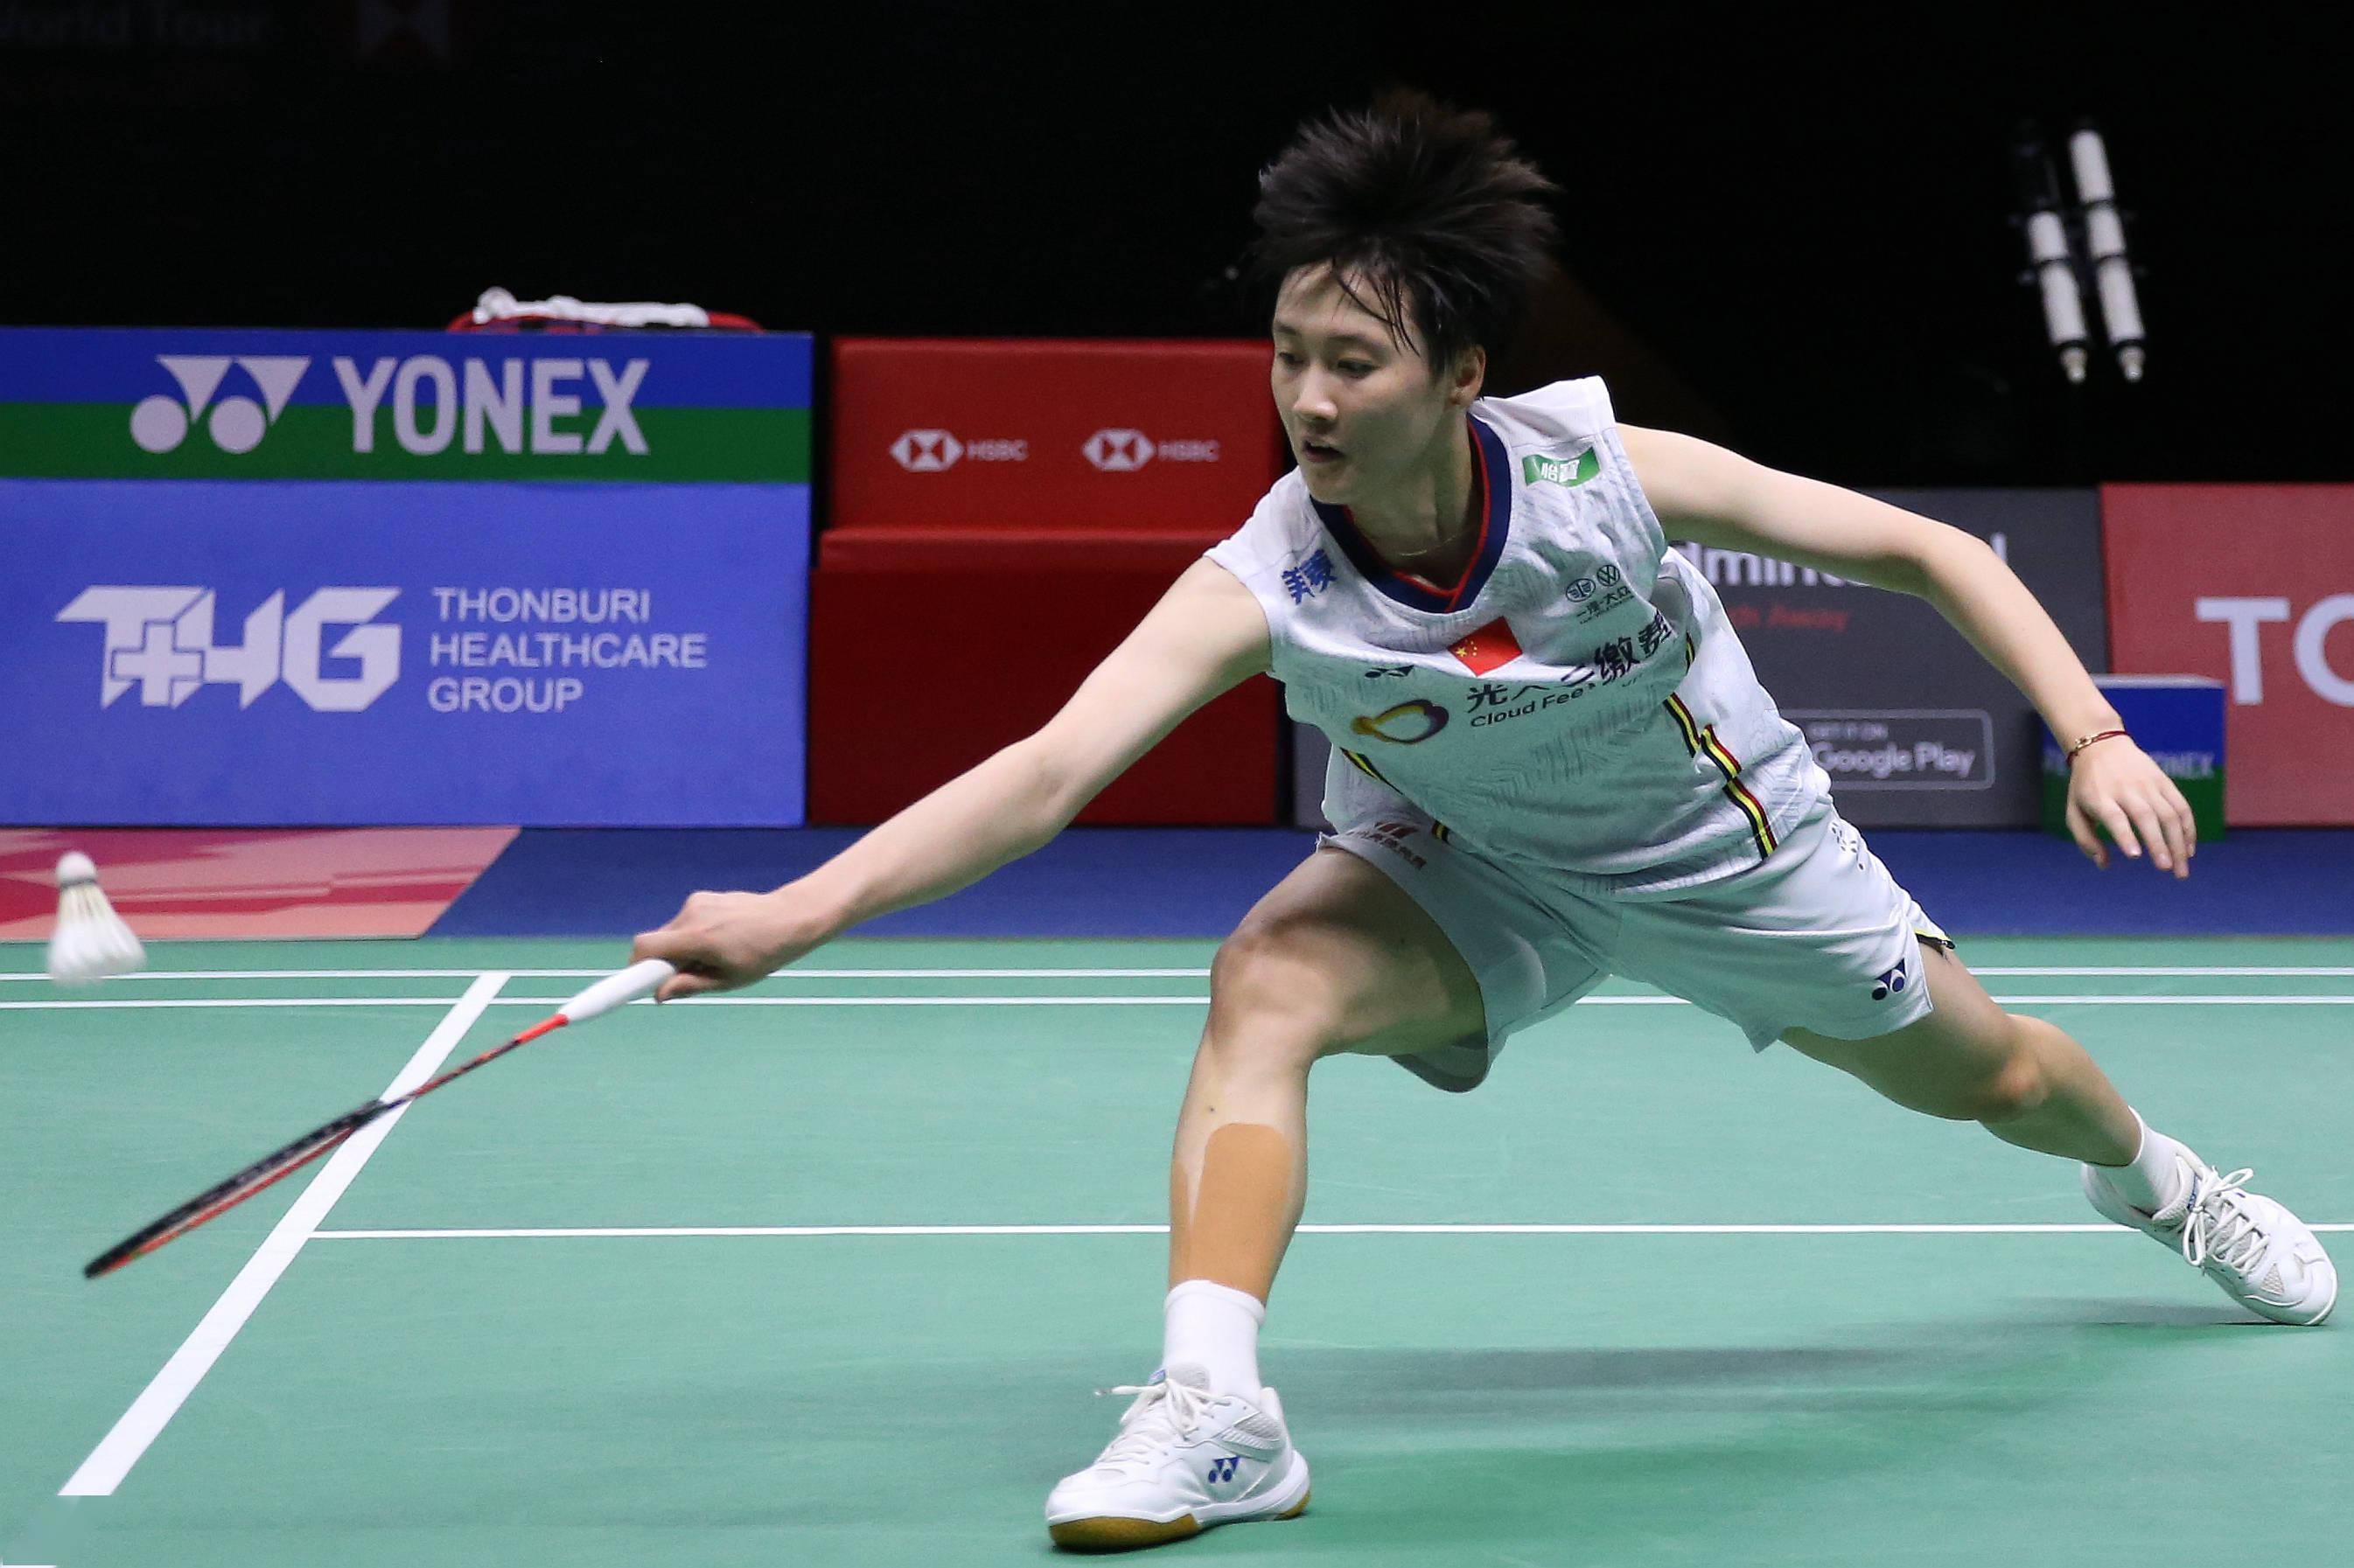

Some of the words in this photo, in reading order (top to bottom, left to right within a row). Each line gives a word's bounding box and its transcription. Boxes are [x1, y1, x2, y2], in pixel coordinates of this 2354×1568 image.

[332, 355, 651, 456] YONEX
[967, 439, 1029, 462] HSBC
[1156, 439, 1219, 462] HSBC
[432, 587, 651, 624] THONBURI
[54, 585, 402, 712] THG
[430, 632, 708, 669] HEALTHCARE
[428, 677, 583, 713] GROUP
[1470, 699, 1535, 728] Cloud
[1542, 687, 1583, 708] Fee
[1810, 742, 1911, 779] Google
[1914, 742, 1976, 778] Play
